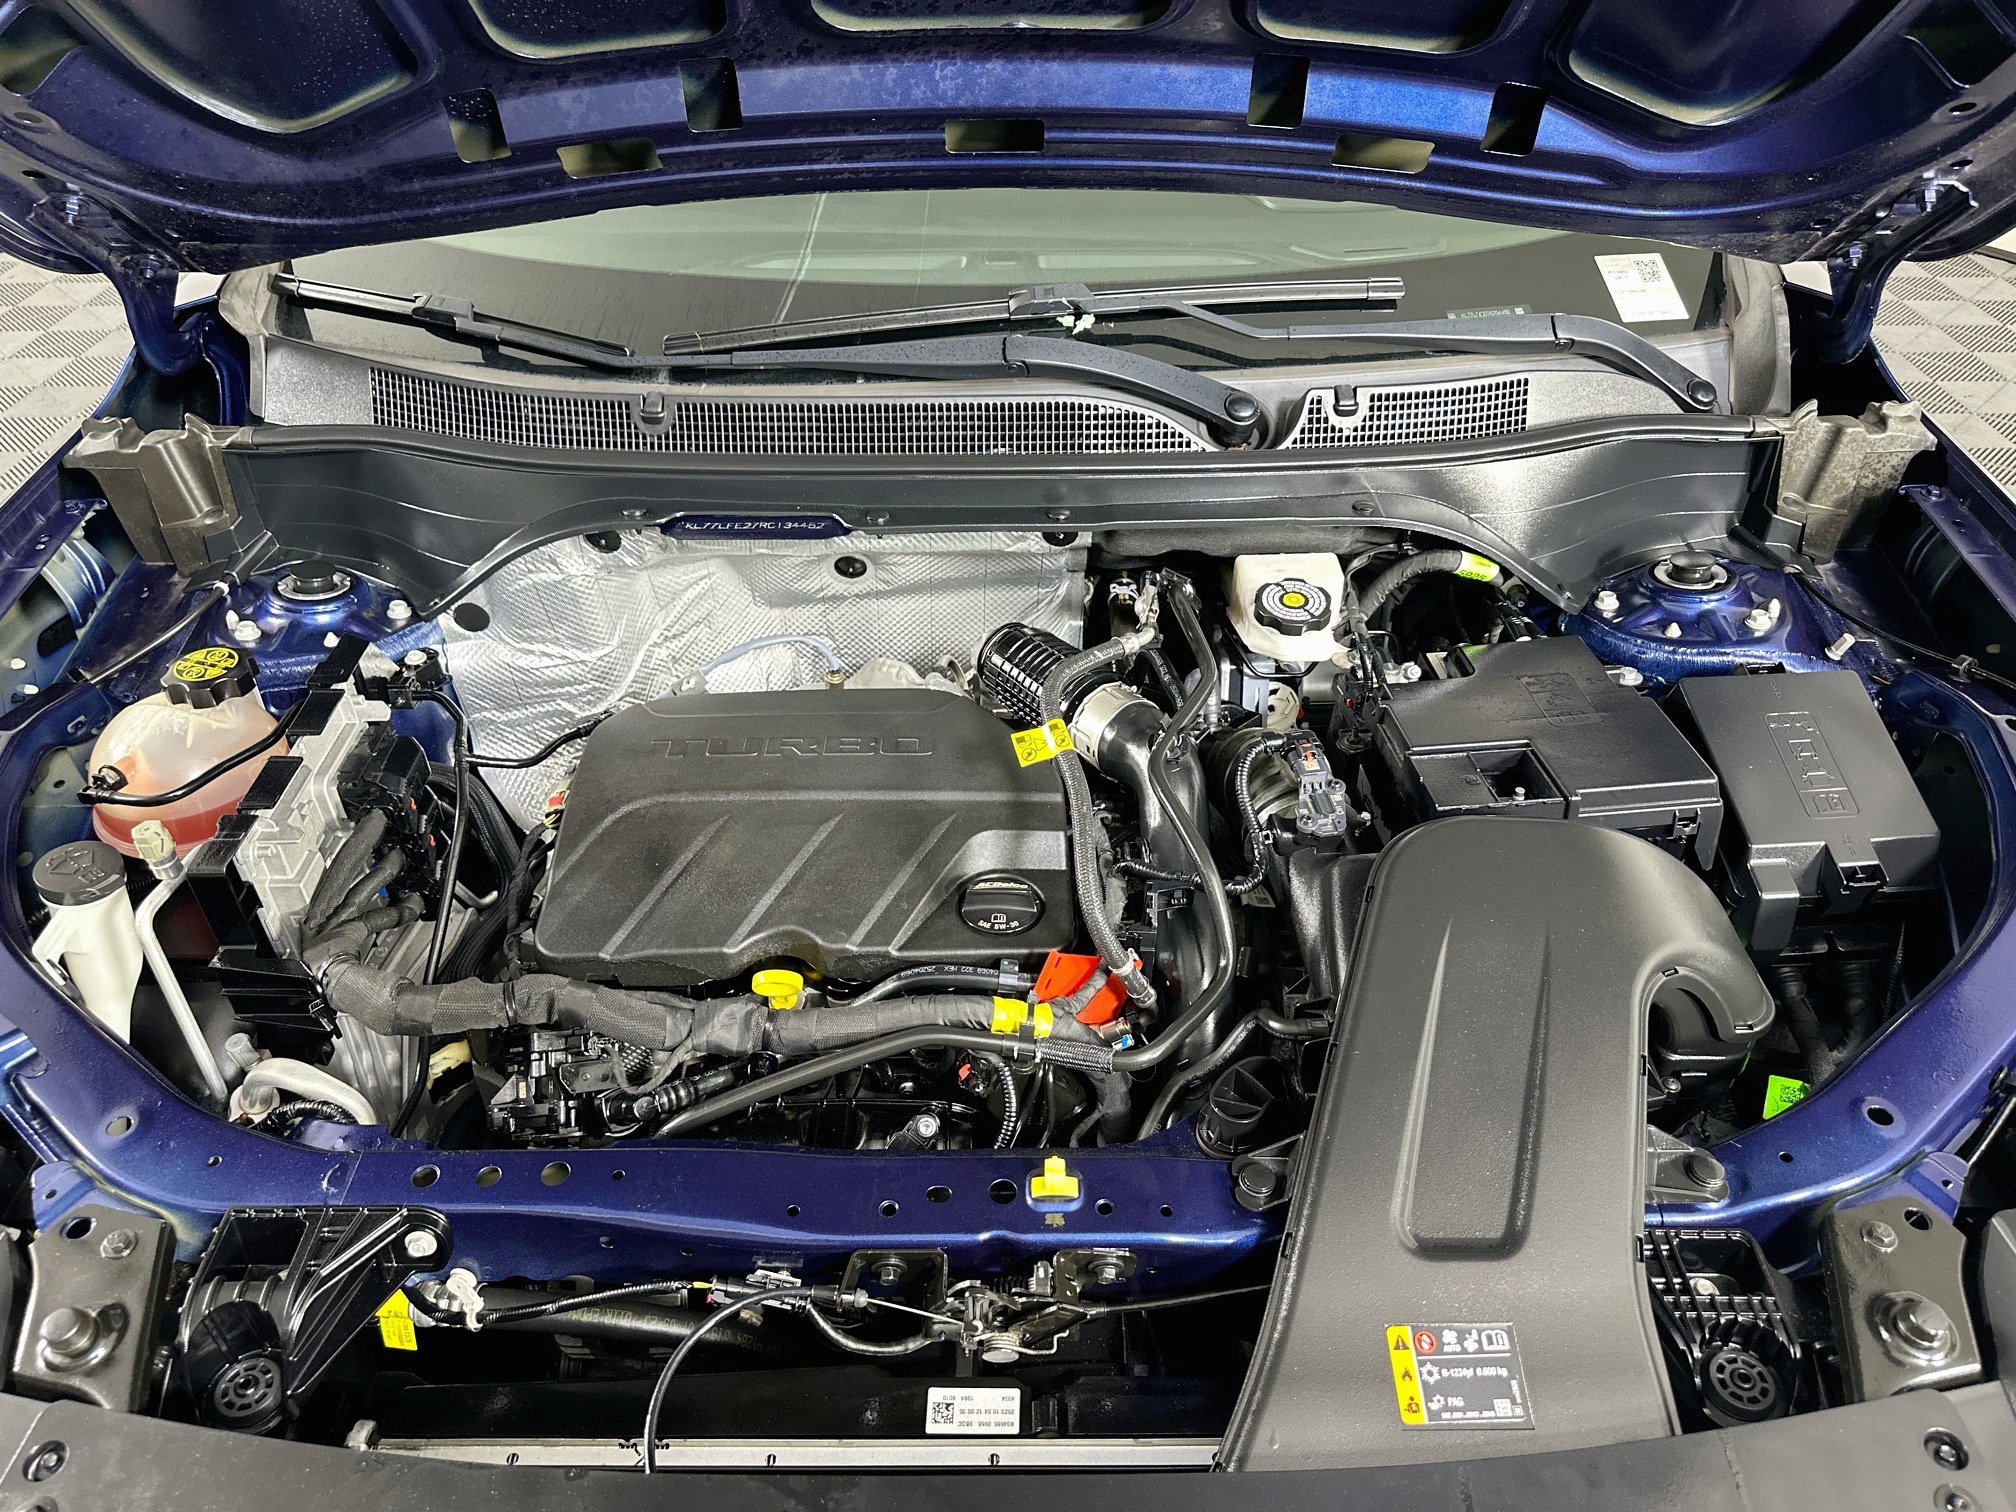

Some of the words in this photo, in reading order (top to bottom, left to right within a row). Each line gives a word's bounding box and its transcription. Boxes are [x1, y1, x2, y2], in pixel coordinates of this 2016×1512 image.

[651, 736, 936, 758] TURBO
[978, 919, 992, 929] SAE
[994, 920, 1020, 930] 5W-30
[1443, 1344, 1462, 1353] AUTO
